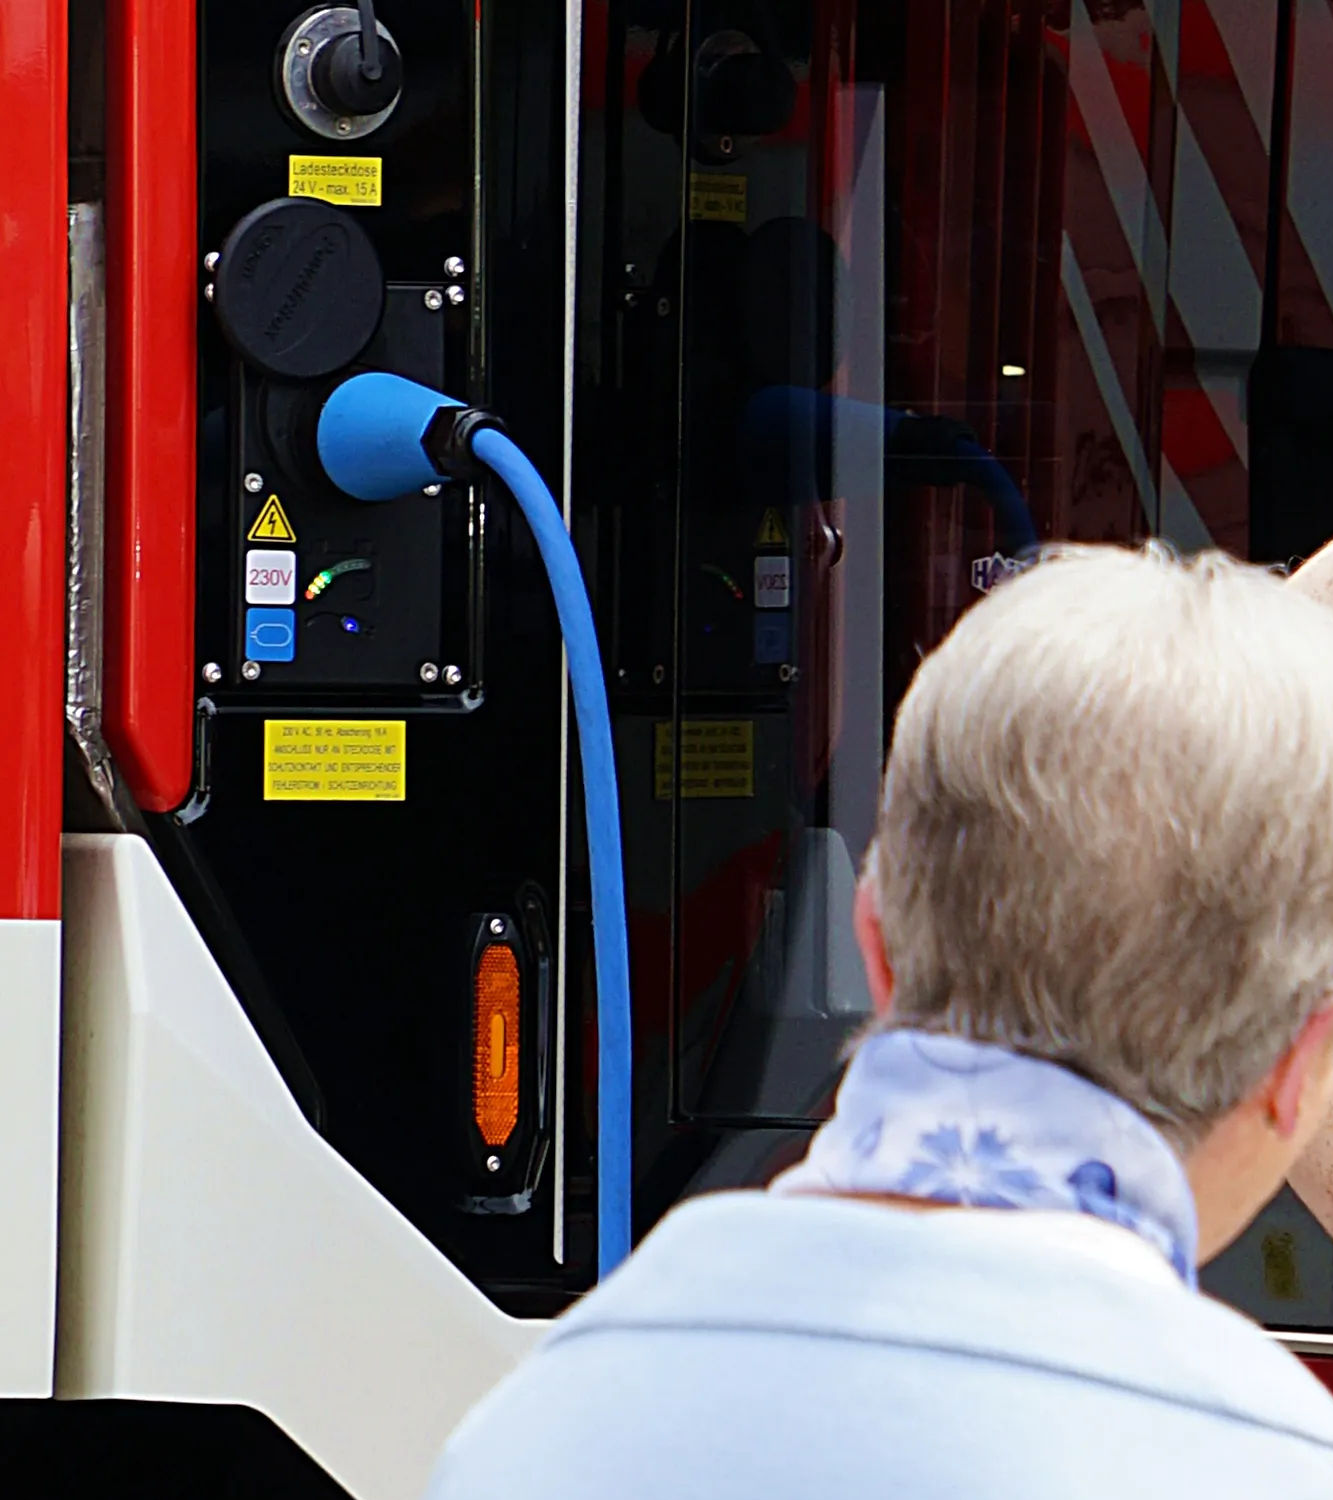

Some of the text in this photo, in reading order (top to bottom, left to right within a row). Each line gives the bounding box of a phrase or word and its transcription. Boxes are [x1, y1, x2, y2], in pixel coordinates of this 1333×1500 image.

[293, 161, 378, 178] Ladesteckdose
[292, 180, 305, 194] 24
[308, 181, 317, 194] V
[248, 568, 293, 587] 230V
